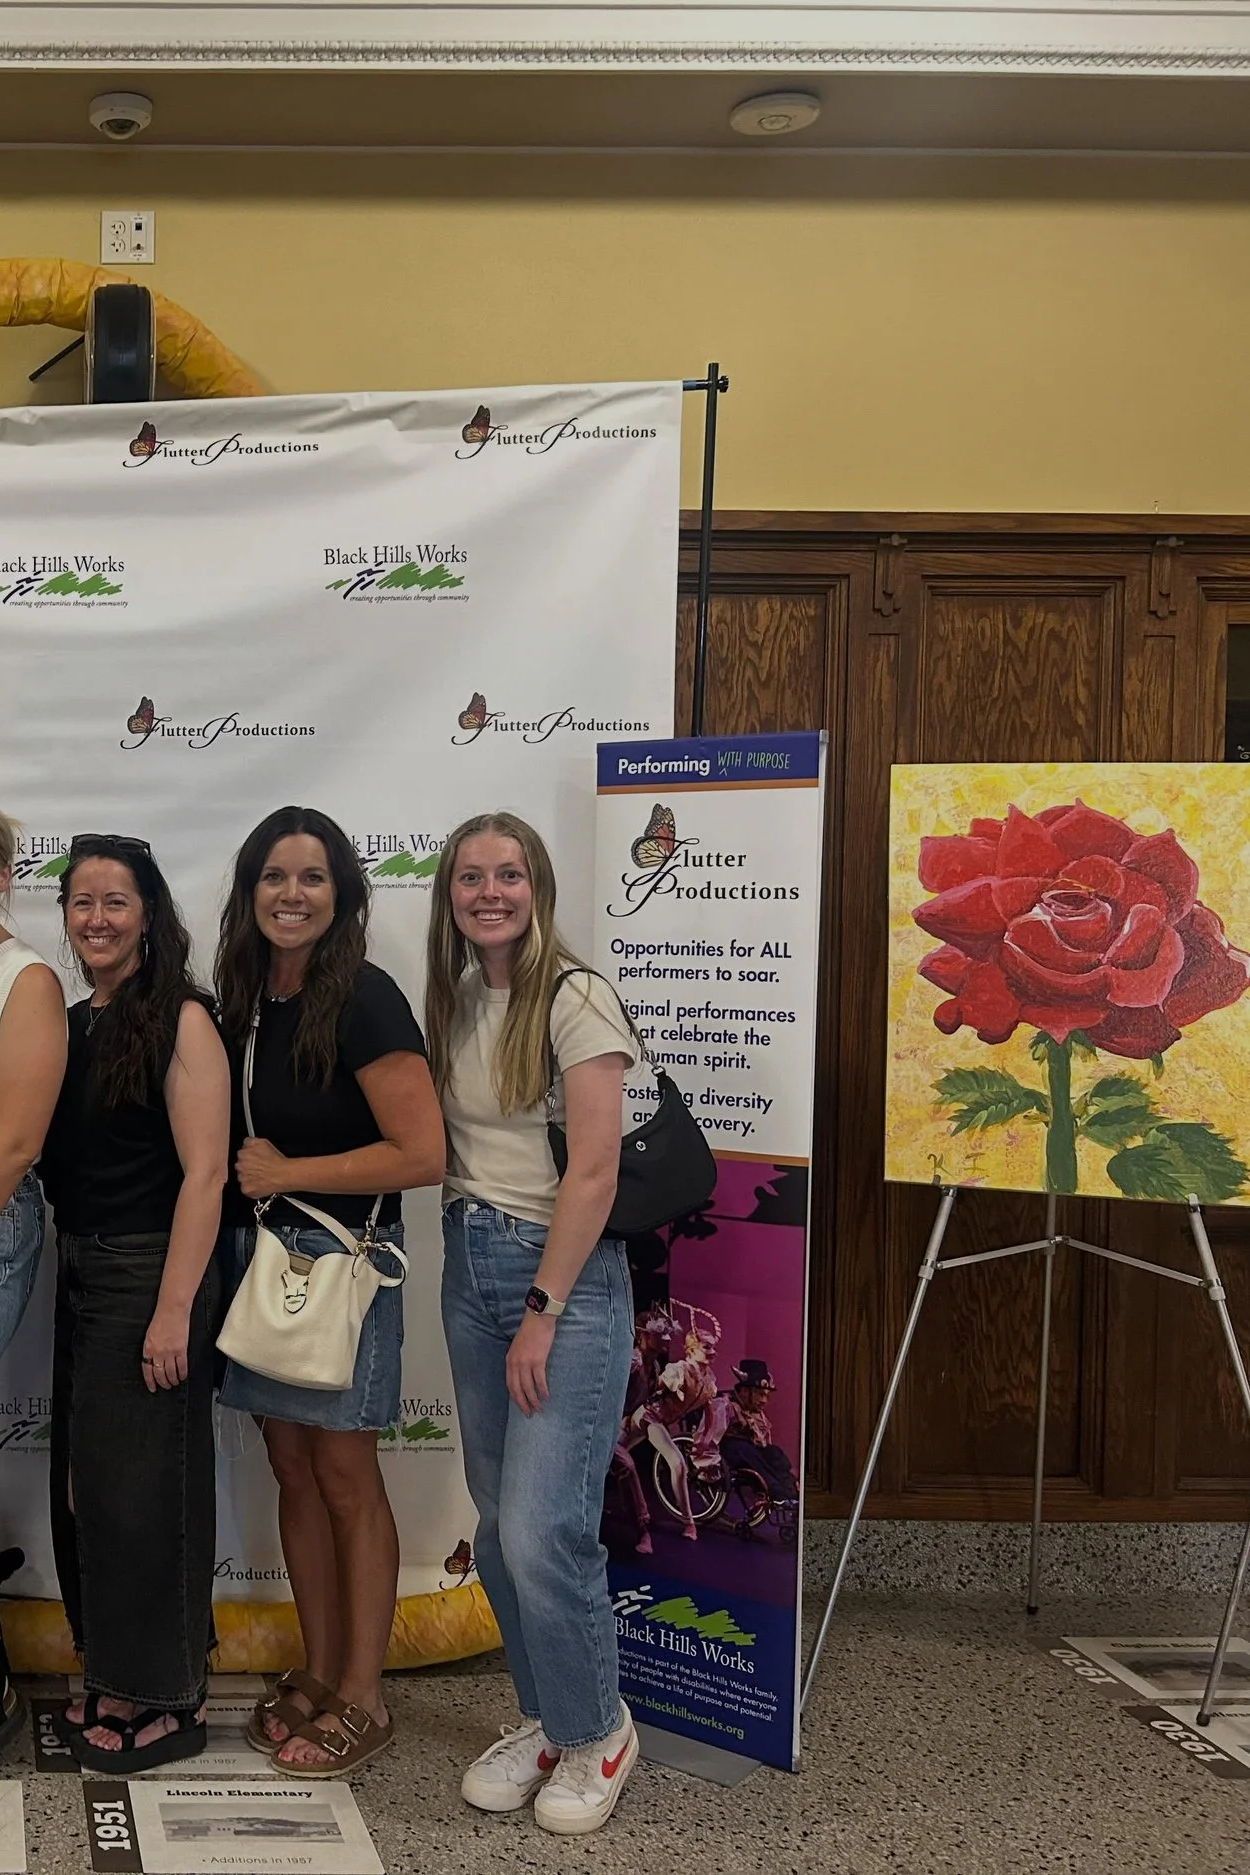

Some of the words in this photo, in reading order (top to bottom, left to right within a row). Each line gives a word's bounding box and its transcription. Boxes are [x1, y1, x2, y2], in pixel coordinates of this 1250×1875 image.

[123, 439, 205, 467] Flutter
[191, 433, 319, 465] Productions
[455, 423, 540, 459] Flutter
[526, 417, 657, 454] Productions
[32, 556, 69, 573] Hills
[74, 555, 125, 572] Works
[323, 546, 368, 566] Black
[373, 545, 412, 565] Hills
[416, 545, 468, 564] Works
[120, 715, 203, 750] Flutter
[188, 713, 316, 749] Productions
[451, 711, 537, 746] Flutter
[523, 707, 650, 744] Productions
[618, 755, 711, 776] Performing
[717, 751, 742, 767] WITH
[746, 752, 791, 769] PURPOSE
[31, 836, 67, 855] Hills
[366, 835, 405, 852] Hills
[409, 834, 450, 852] Wor
[606, 837, 747, 918] Flutter
[621, 864, 800, 903] Productions
[611, 938, 724, 960] Opportunities
[730, 939, 755, 957] for
[760, 941, 792, 959] ALL
[618, 961, 710, 982] performers
[716, 966, 732, 981] to
[738, 970, 780, 983] soar.
[625, 998, 670, 1020] iginal
[676, 1001, 796, 1023] performances
[661, 1024, 738, 1044] celebrate
[744, 1027, 771, 1046] the
[703, 1052, 751, 1072] spirit.
[700, 1088, 774, 1115] diversity
[695, 1115, 756, 1137] covery.
[402, 1398, 452, 1417] Works
[213, 1557, 290, 1581] Productio
[614, 1617, 655, 1645] Black
[659, 1629, 697, 1657] Hills
[701, 1641, 755, 1674] Works
[640, 1666, 663, 1677] people
[719, 1689, 742, 1701] where
[743, 1697, 777, 1712] everyone
[655, 1659, 669, 1668] part
[679, 1665, 690, 1674] the
[692, 1668, 711, 1680] Black
[712, 1674, 727, 1685] Hills
[730, 1680, 753, 1694] Works
[639, 1675, 665, 1689] achieve
[694, 1693, 723, 1707] purpose
[724, 1701, 738, 1711] and
[1150, 1720, 1231, 1762] 1930
[166, 1789, 223, 1797] Lincoln
[227, 1790, 312, 1798] Elementary
[94, 1800, 132, 1851] 1951
[210, 1856, 268, 1864] Additions
